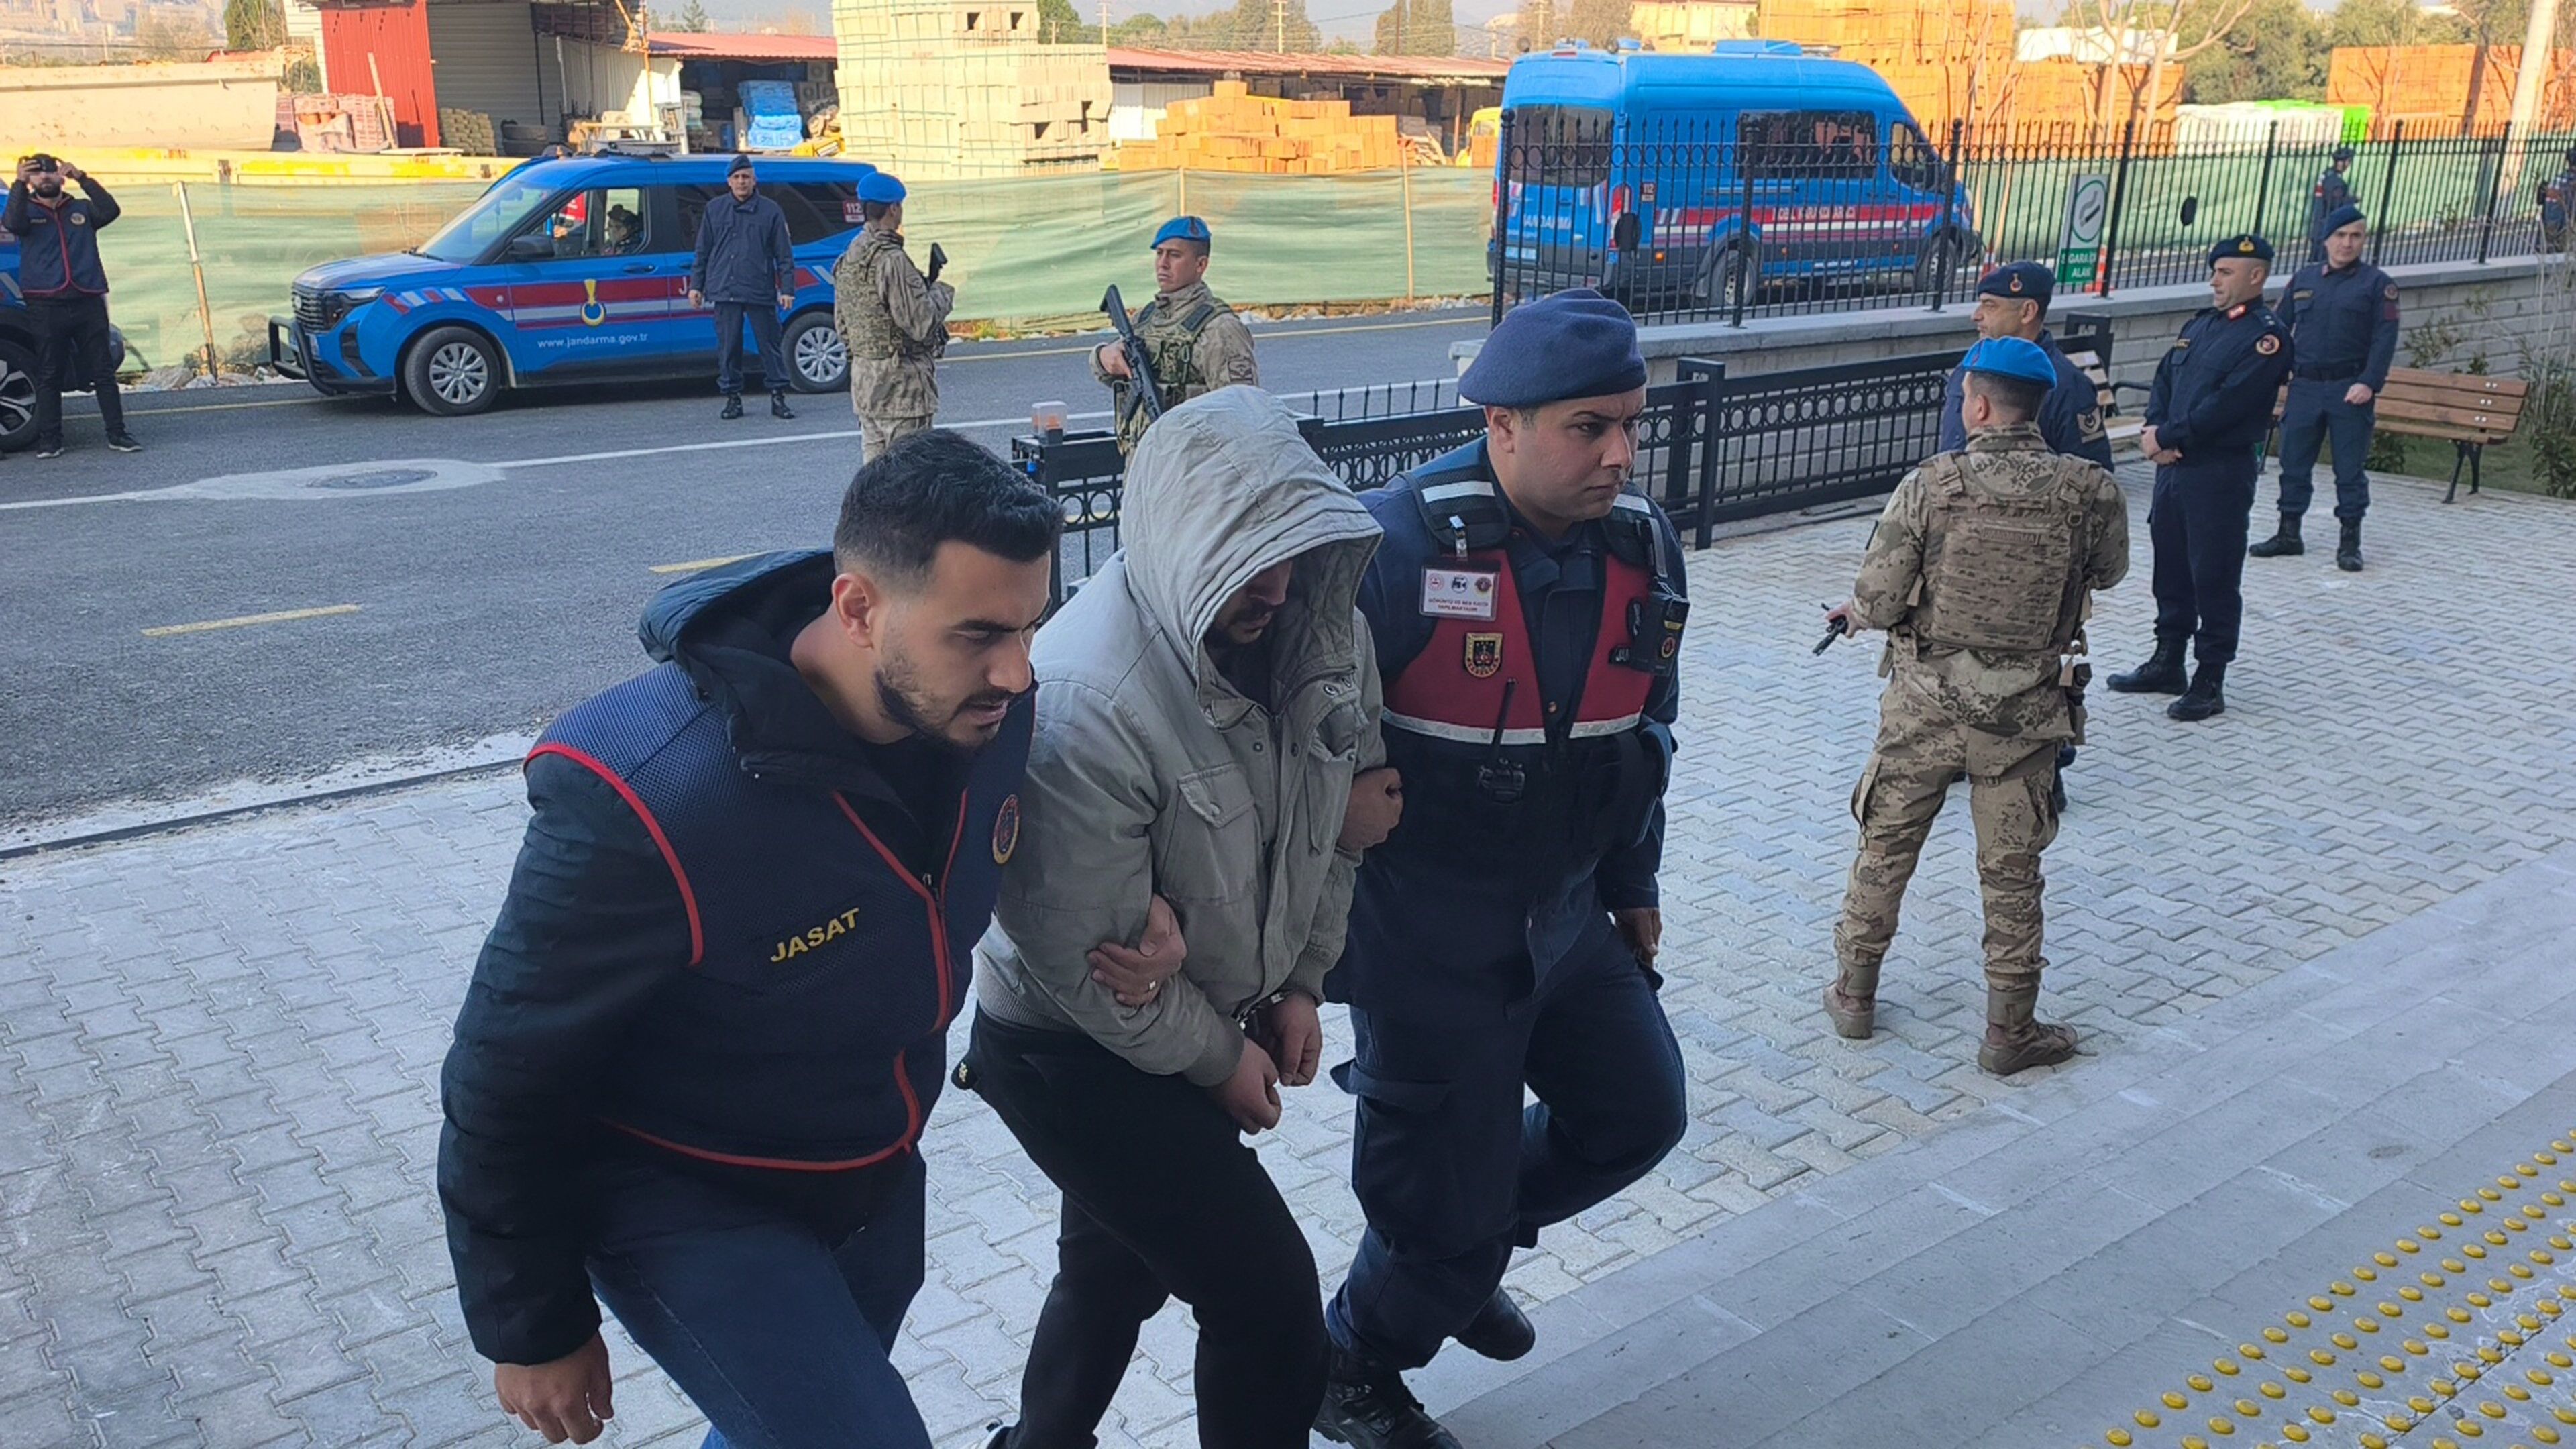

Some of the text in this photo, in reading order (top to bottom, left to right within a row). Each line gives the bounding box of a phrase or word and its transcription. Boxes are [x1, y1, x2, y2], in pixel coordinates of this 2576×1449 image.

[846, 203, 863, 213] 112
[2061, 252, 2088, 264] SGARA
[537, 333, 648, 348] www.jandarma.gov.tr
[770, 908, 859, 962] JASAT
